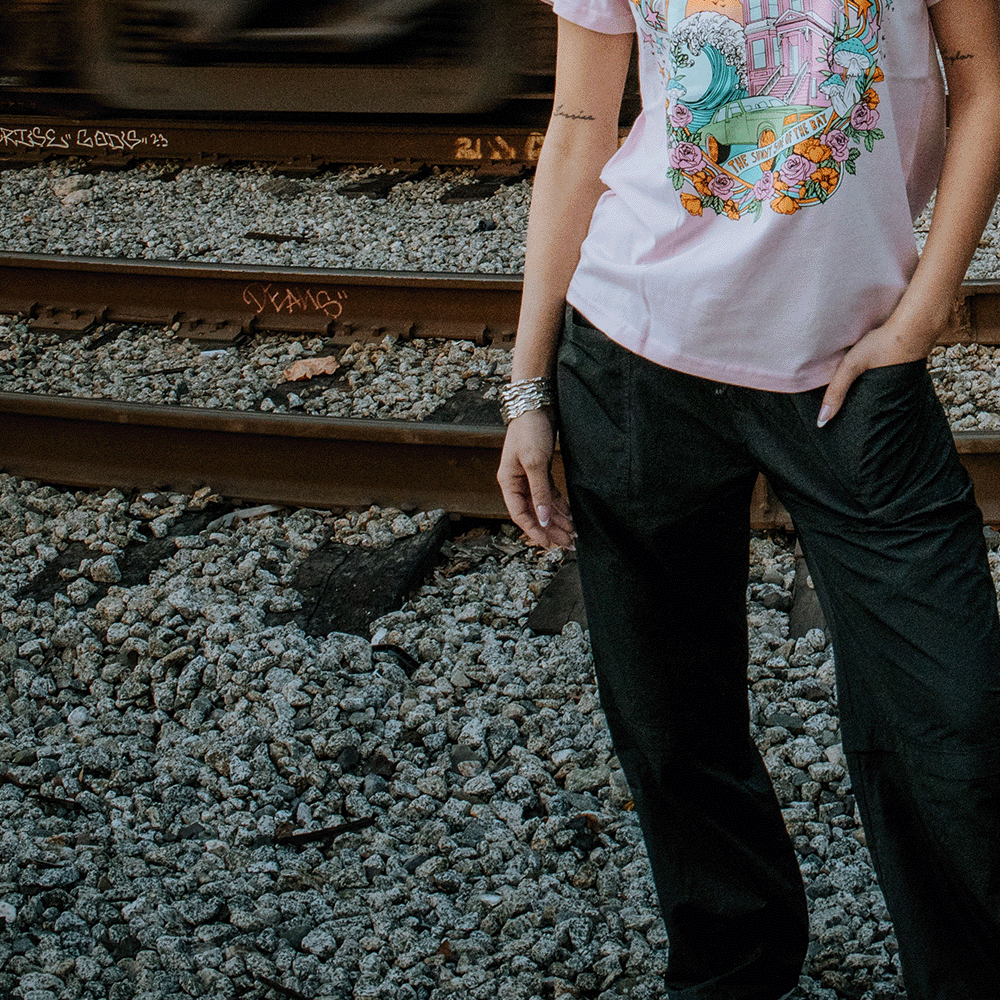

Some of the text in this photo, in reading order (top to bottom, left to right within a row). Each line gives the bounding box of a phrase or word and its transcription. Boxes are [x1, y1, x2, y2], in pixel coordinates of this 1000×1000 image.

[728, 153, 749, 173] THE
[785, 130, 792, 145] OF
[793, 123, 810, 140] THE
[809, 113, 828, 131] BAY
